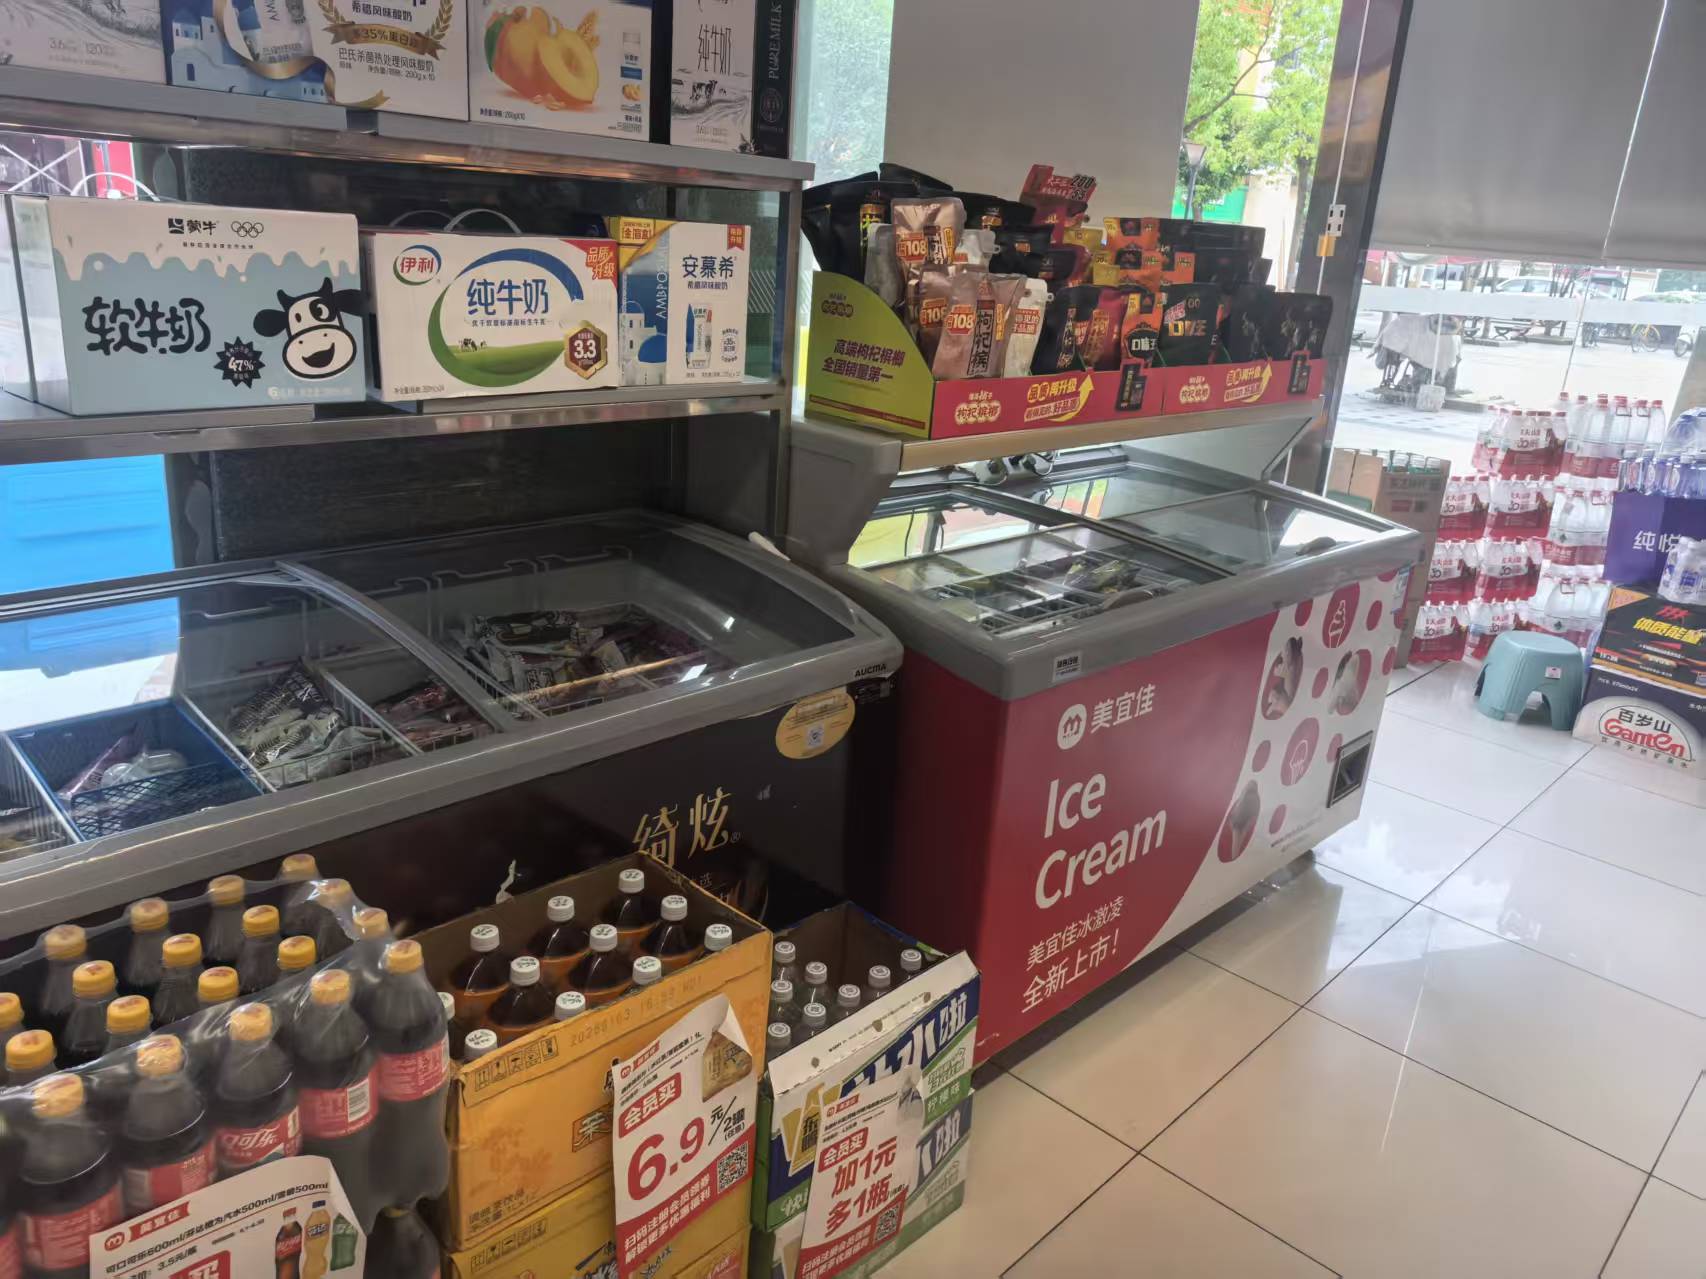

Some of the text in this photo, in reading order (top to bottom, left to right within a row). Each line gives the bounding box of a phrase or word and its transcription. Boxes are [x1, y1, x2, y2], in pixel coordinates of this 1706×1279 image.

[187, 220, 217, 236] 蒙牛
[400, 257, 434, 274] 伊利
[587, 247, 613, 263] 品质
[906, 240, 927, 256] 108
[592, 263, 614, 280] 升级
[682, 254, 734, 279] 安慕希
[467, 278, 549, 316] 纯牛奶
[82, 297, 211, 354] 软牛奶
[953, 314, 974, 329] 108
[228, 357, 254, 371] 47%
[574, 340, 597, 359] 3.3
[822, 357, 893, 382] 全国销量第一
[1091, 684, 1155, 733] 美宜佳
[1619, 708, 1671, 733] 百岁山
[1044, 772, 1106, 839] Ice
[1035, 810, 1167, 909] Cream
[1026, 895, 1124, 972] 美宜佳冰激凌
[1021, 929, 1119, 1013] 全新上市!
[624, 1081, 677, 1129] 会员买
[628, 1117, 705, 1200] 6.9
[823, 1131, 864, 1167] 会员买
[832, 1136, 897, 1198] 加1元
[825, 1173, 893, 1237] 多1瓶
